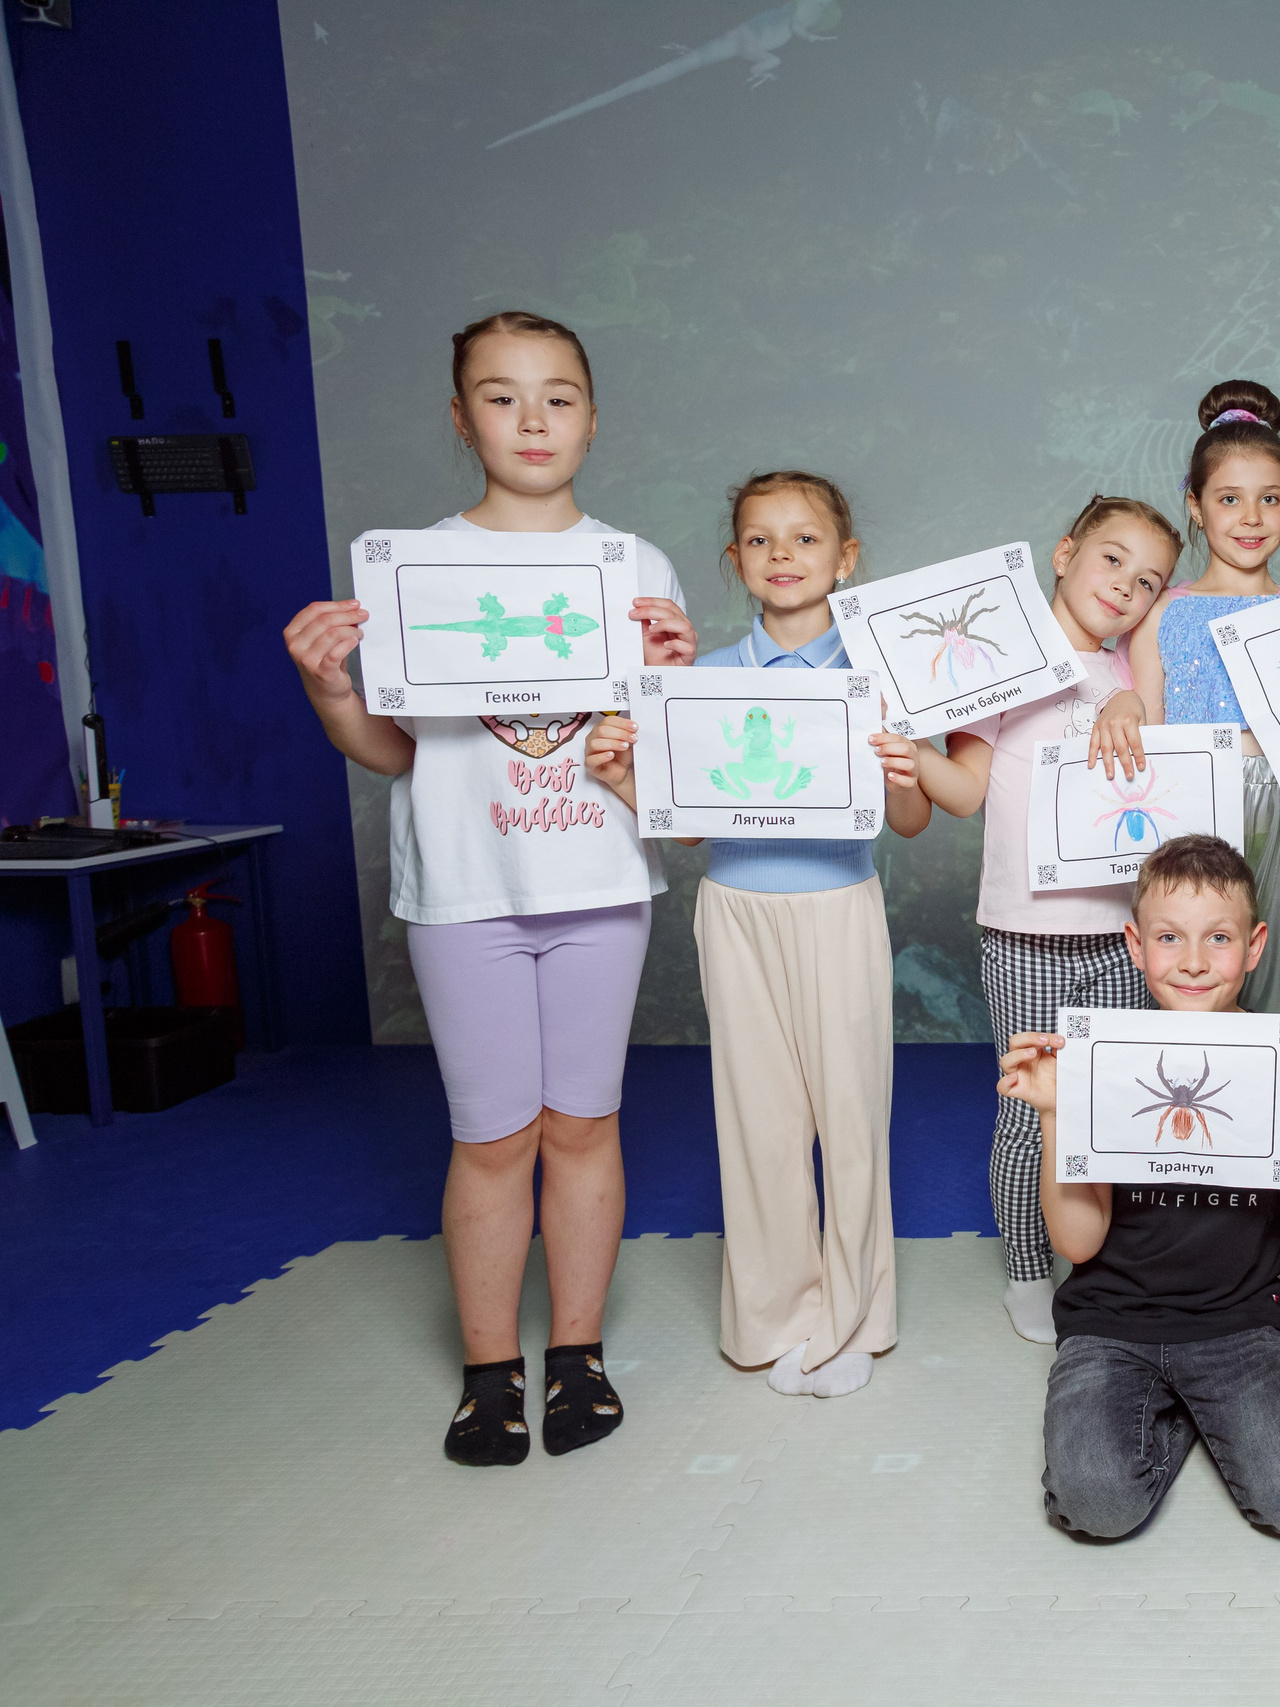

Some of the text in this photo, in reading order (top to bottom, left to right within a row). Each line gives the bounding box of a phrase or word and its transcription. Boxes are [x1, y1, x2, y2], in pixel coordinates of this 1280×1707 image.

[485, 691, 541, 703] Геккон
[945, 686, 1022, 720] Паук бабуин
[508, 757, 580, 795] Best
[490, 796, 605, 836] Buddies
[732, 813, 795, 828] Лягушка
[1109, 862, 1142, 875] Тара
[1147, 1161, 1214, 1176] Тарантул
[1131, 1190, 1259, 1208] HILFIGER
